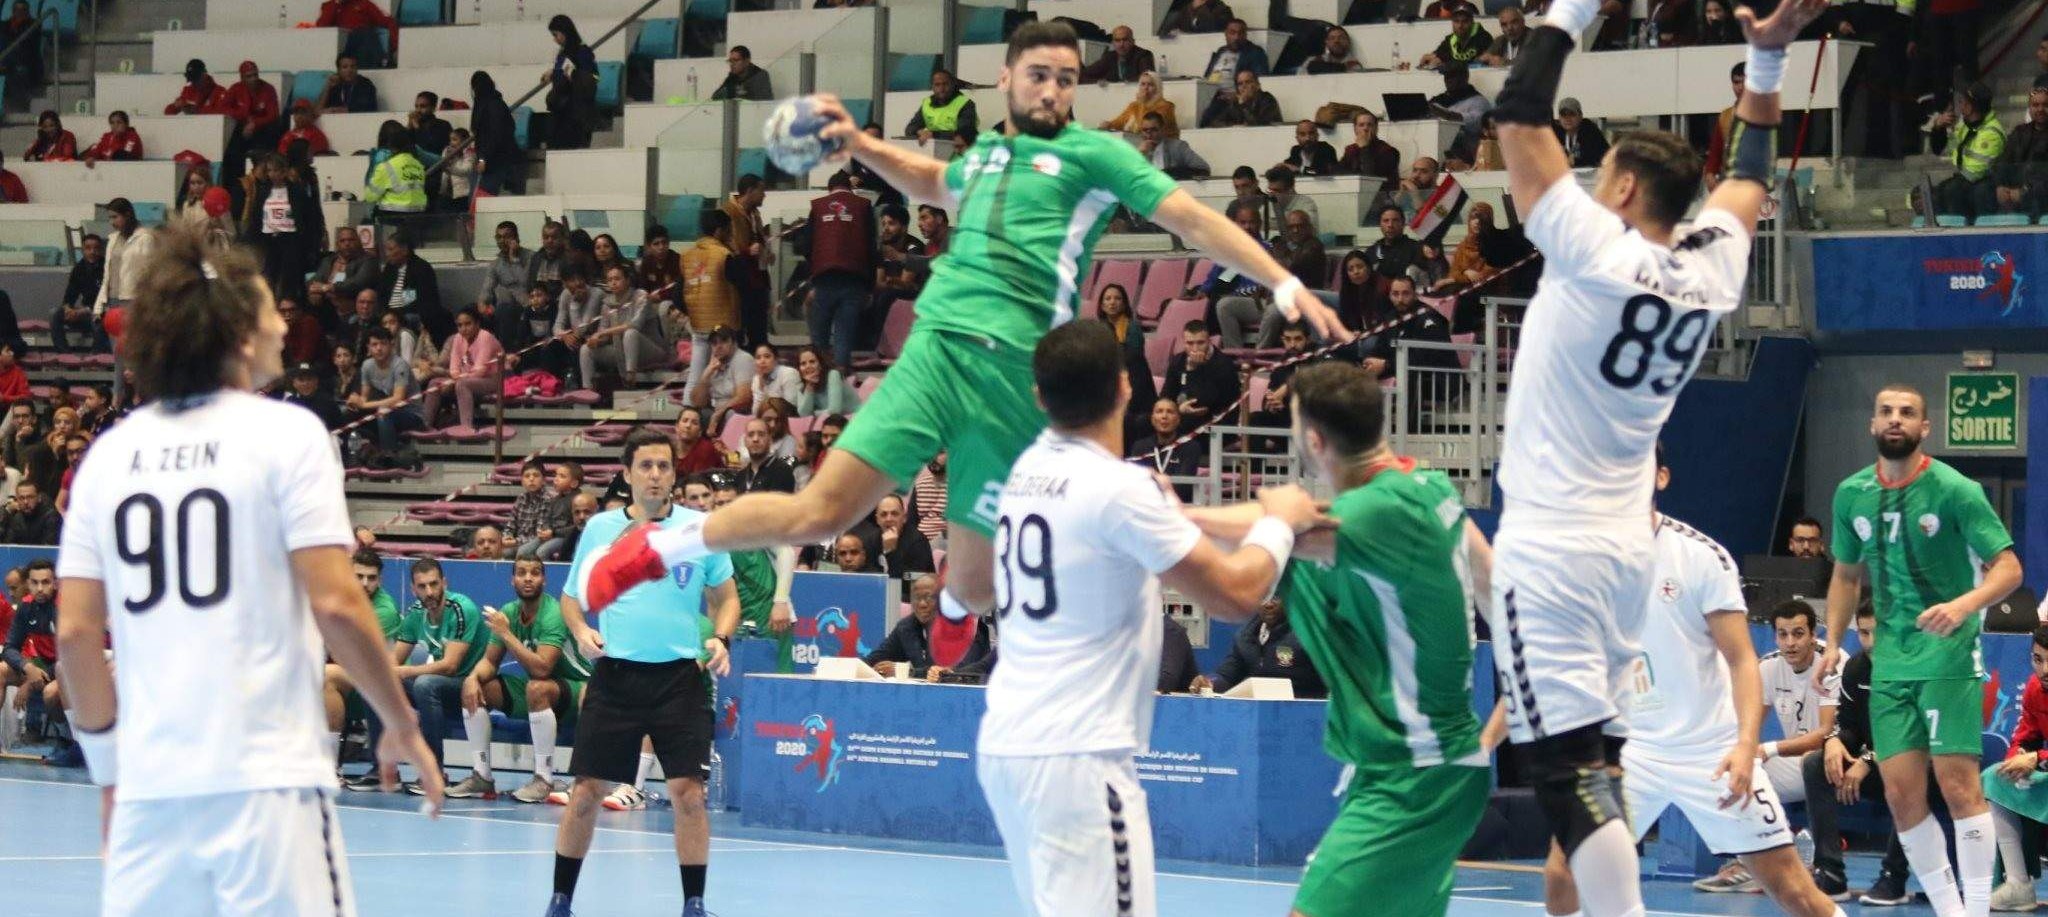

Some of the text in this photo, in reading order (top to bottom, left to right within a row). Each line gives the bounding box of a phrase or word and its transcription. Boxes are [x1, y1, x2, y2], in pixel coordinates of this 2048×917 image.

[1951, 276, 1985, 290] 2020
[1600, 293, 1709, 396] 89
[1952, 380, 2012, 415] خروج
[1952, 417, 2011, 441] SORTIE
[129, 441, 220, 474] A. ZEIN
[1882, 512, 1901, 543] 7
[115, 487, 231, 613] 90
[998, 514, 1057, 621] 39
[1925, 709, 1940, 739] 7
[776, 741, 807, 756] 2020
[1754, 788, 1777, 824] 5
